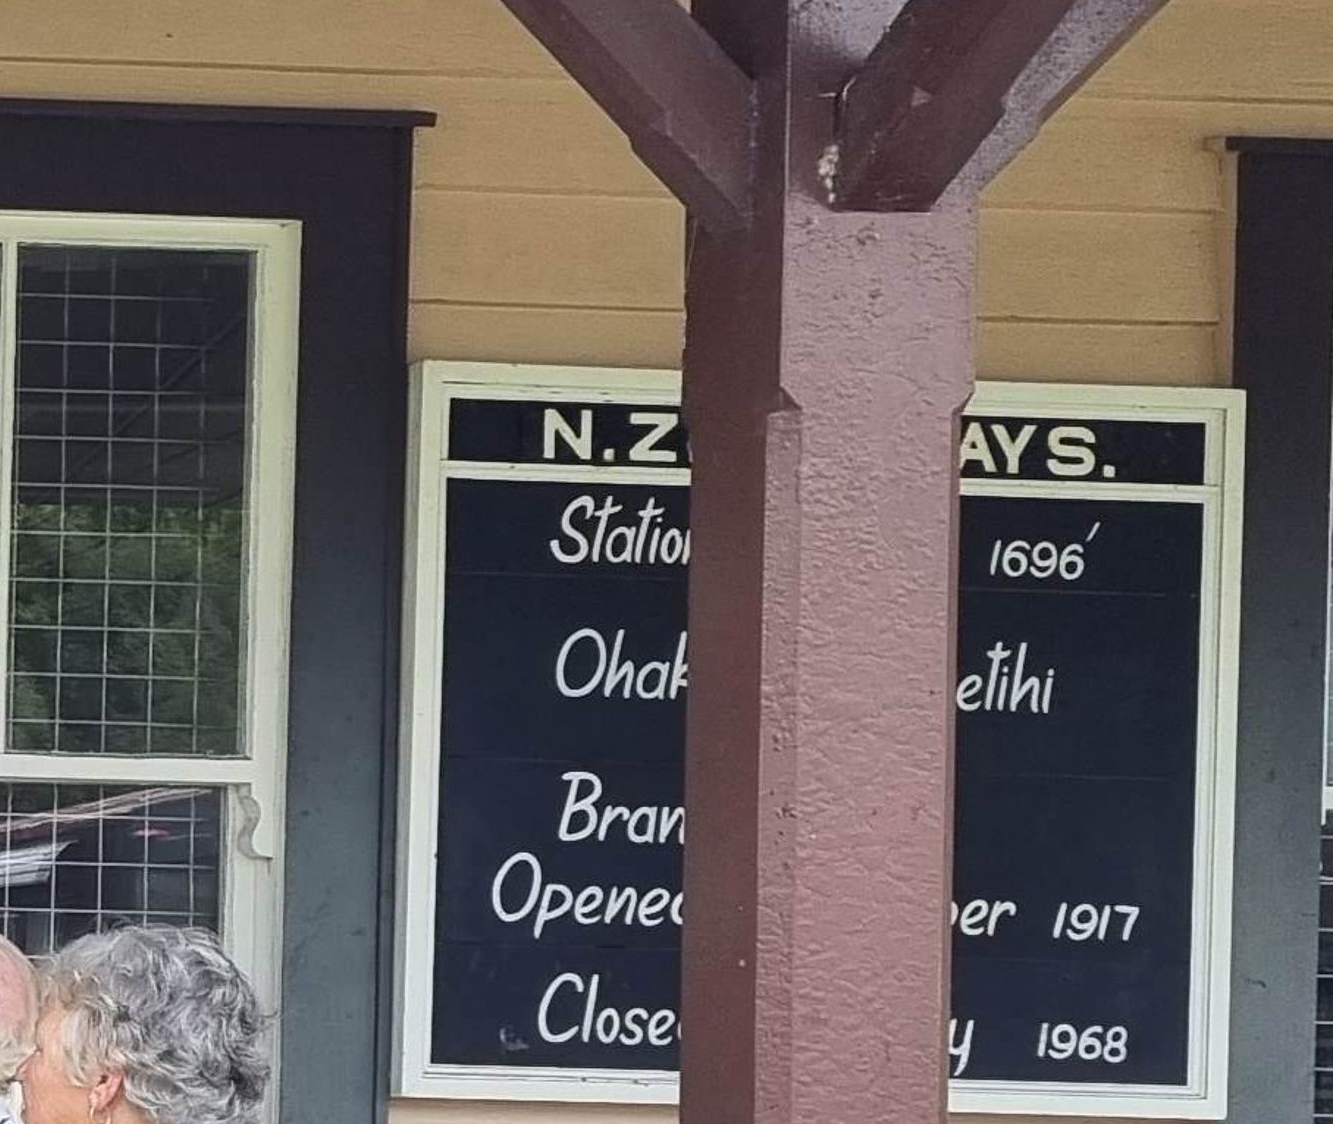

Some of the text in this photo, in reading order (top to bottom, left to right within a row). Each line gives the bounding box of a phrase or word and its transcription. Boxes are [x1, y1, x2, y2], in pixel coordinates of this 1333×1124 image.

[549, 495, 691, 565] Statio
[1053, 902, 1140, 941] 1917
[537, 972, 682, 1046] Close
[1037, 1022, 1128, 1063] 1968
